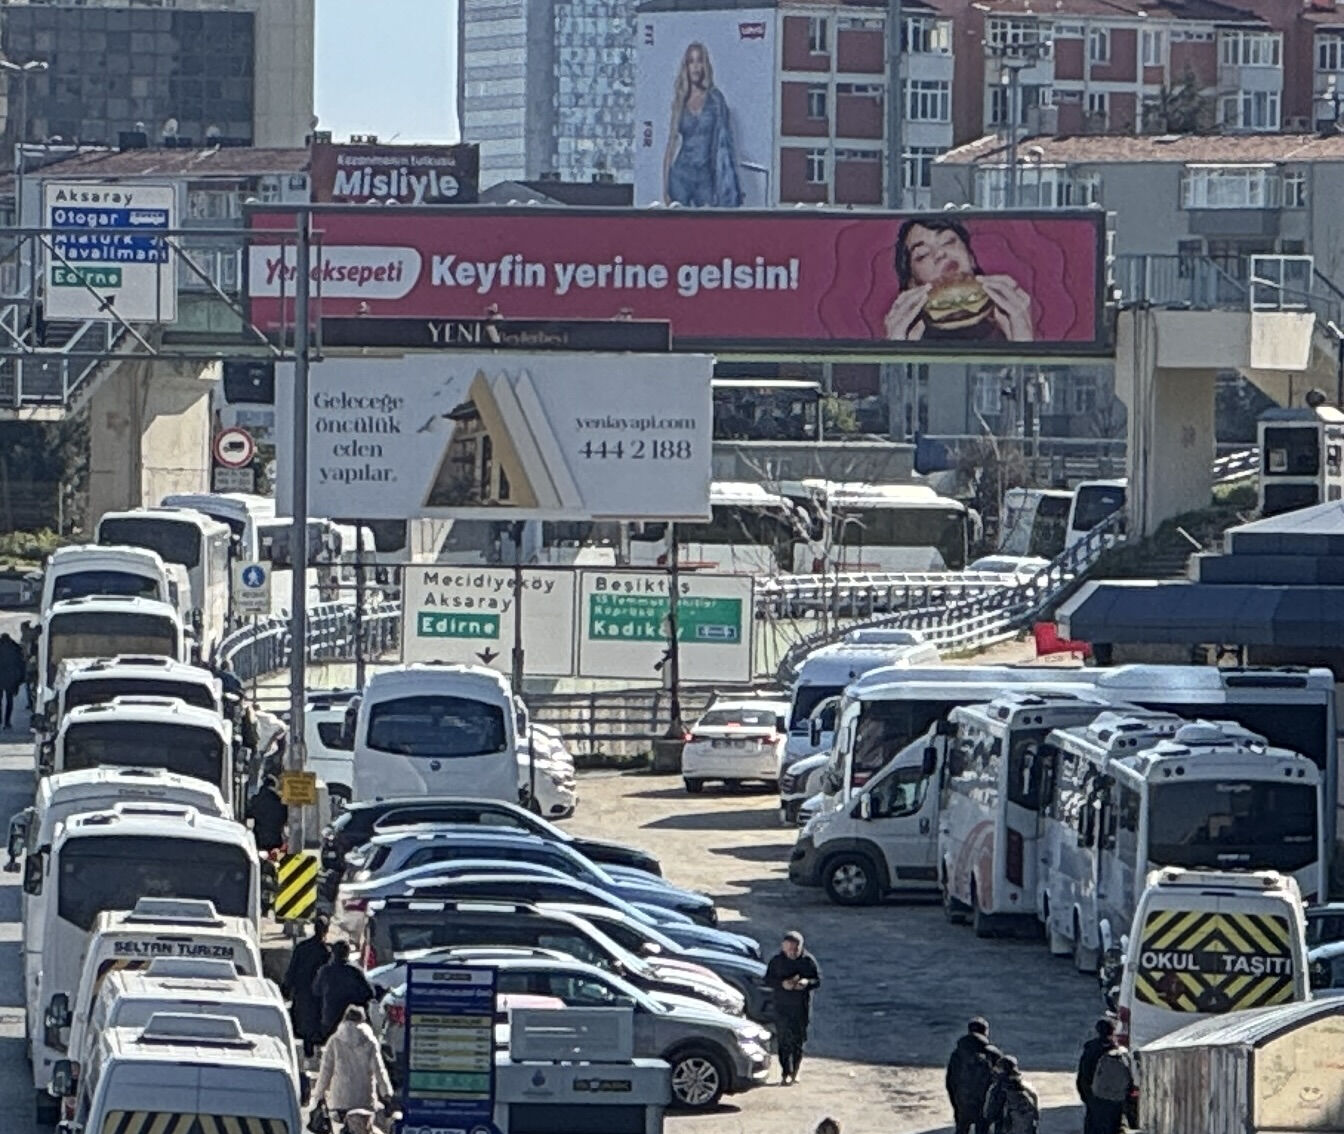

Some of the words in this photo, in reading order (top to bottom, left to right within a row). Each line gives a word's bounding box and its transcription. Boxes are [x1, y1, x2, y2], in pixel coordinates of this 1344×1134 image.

[642, 121, 653, 147] FOR
[333, 167, 459, 205] Misliyle
[56, 189, 134, 206] Aksaray
[55, 210, 119, 227] Otogar
[431, 254, 546, 294] Keyfin
[554, 256, 669, 294] yerine
[677, 256, 800, 296] gelsin!
[314, 392, 403, 411] Geleceğe
[315, 416, 401, 434] öncülük
[333, 442, 383, 458] eden
[578, 440, 624, 459] 444
[630, 440, 646, 459] 2
[650, 440, 693, 459] 188
[320, 464, 397, 484] yapılar.
[424, 592, 513, 612] Aksaray
[421, 618, 495, 636] Edirne
[1141, 953, 1200, 971] OKUL
[1222, 955, 1292, 976] TAŞITI
